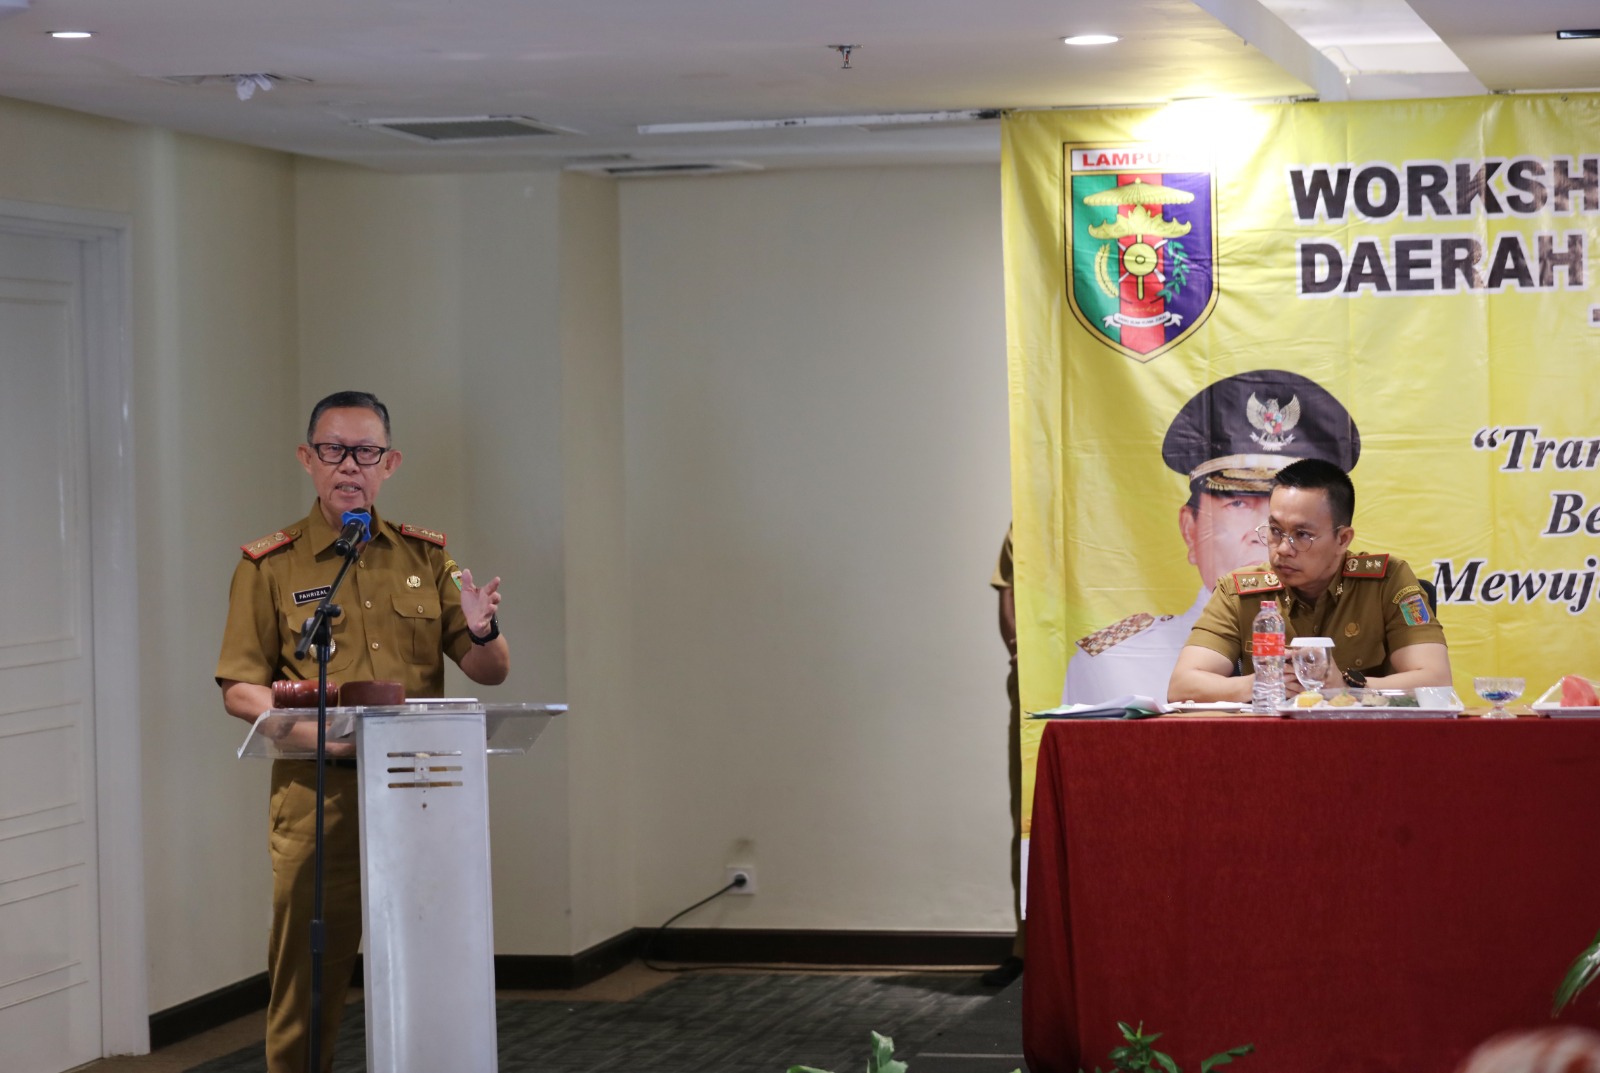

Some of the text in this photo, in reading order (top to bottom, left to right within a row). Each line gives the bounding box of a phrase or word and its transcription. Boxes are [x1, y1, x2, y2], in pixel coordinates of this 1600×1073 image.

[1082, 152, 1174, 167] LAMPU
[1289, 158, 1600, 220] WORKSH
[1300, 234, 1584, 294] DAERAH
[299, 589, 328, 600] FAHRIZAL
[1434, 558, 1600, 613] Mewuj
